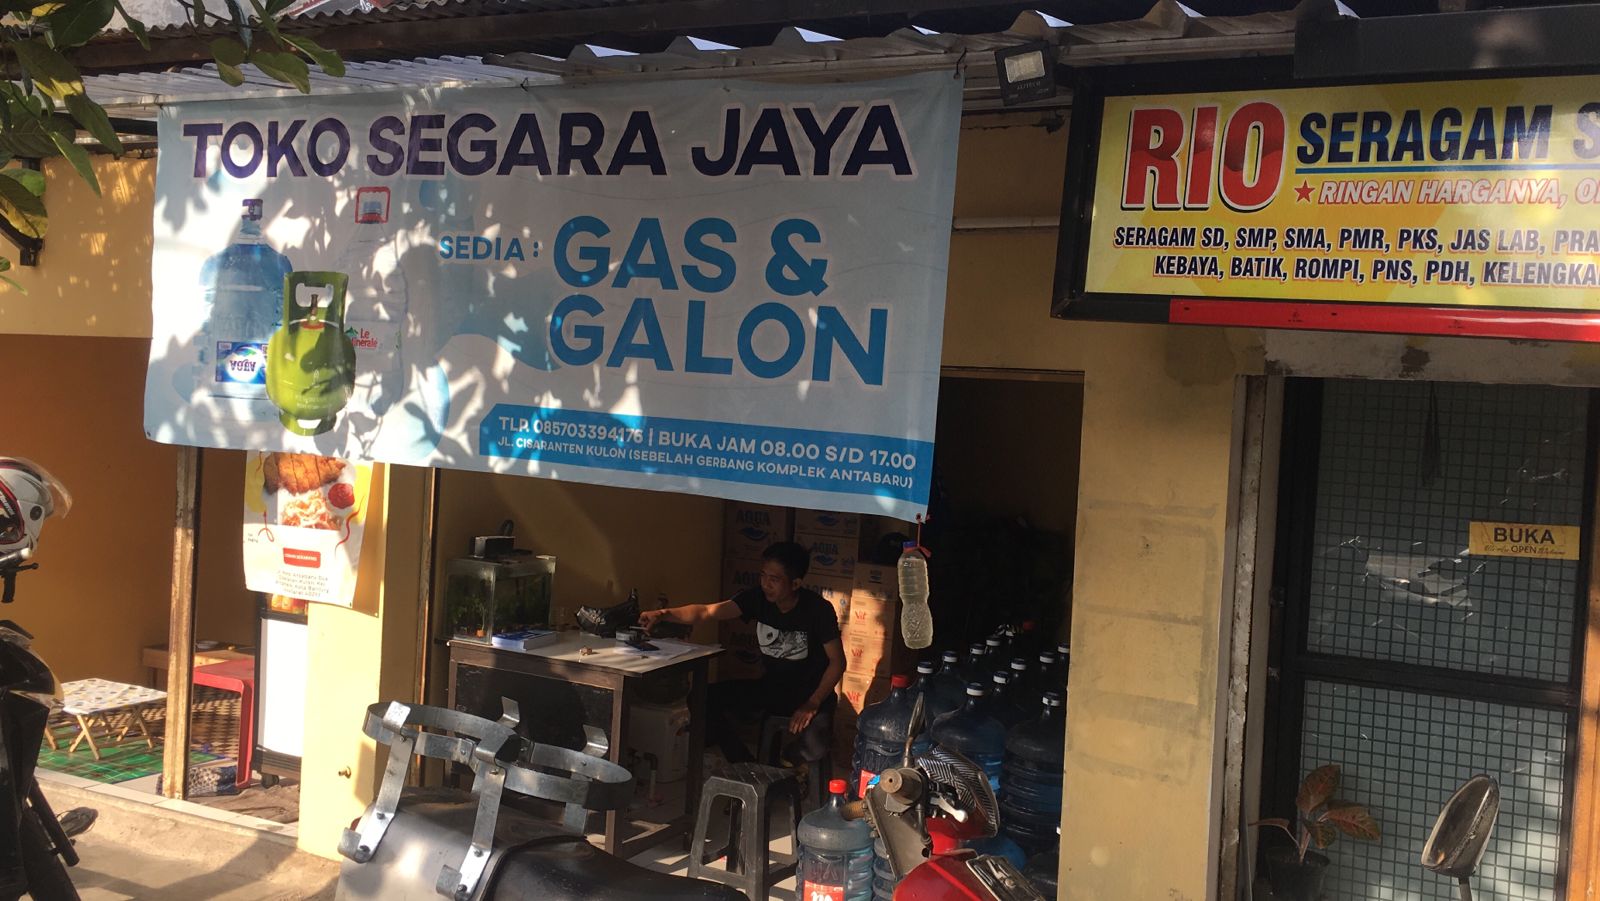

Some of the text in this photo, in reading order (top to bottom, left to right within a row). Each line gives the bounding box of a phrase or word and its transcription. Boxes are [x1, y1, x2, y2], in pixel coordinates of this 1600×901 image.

[183, 104, 913, 178] TOKO SEGARA JAYA
[1121, 101, 1287, 213] RIO
[1296, 105, 1553, 164] SERAGAM
[1318, 179, 1415, 205] RINGAN
[1417, 178, 1568, 209] HARGANYA,
[438, 235, 525, 261] SEDIA
[553, 215, 829, 297] GAS &
[1114, 226, 1196, 248] SERAGAM
[1201, 227, 1230, 251] SD,
[1235, 227, 1278, 252] SMP,
[1284, 228, 1332, 253] SMA,
[1338, 228, 1390, 253] PMR,
[1398, 228, 1444, 254] PKS,
[1449, 229, 1490, 251] JAS
[1497, 229, 1546, 256] LAB,
[1154, 255, 1600, 286] KEBAYA, BATIK, ROMPI, PNS, PDH, KELENGKA
[549, 294, 888, 386] GALON
[498, 436, 913, 489] JL. CISARANTEN KULON (SEBELAH GERBANG KOMPLEK ANTABARU)
[533, 419, 644, 444] 085703394176
[658, 431, 712, 450] BUKA
[717, 436, 756, 454] JAM
[760, 440, 820, 460] 08.00
[825, 447, 864, 464] S/D
[869, 449, 917, 470] 17.00
[1494, 527, 1555, 545] BUKA
[1511, 545, 1537, 554] OPEN
